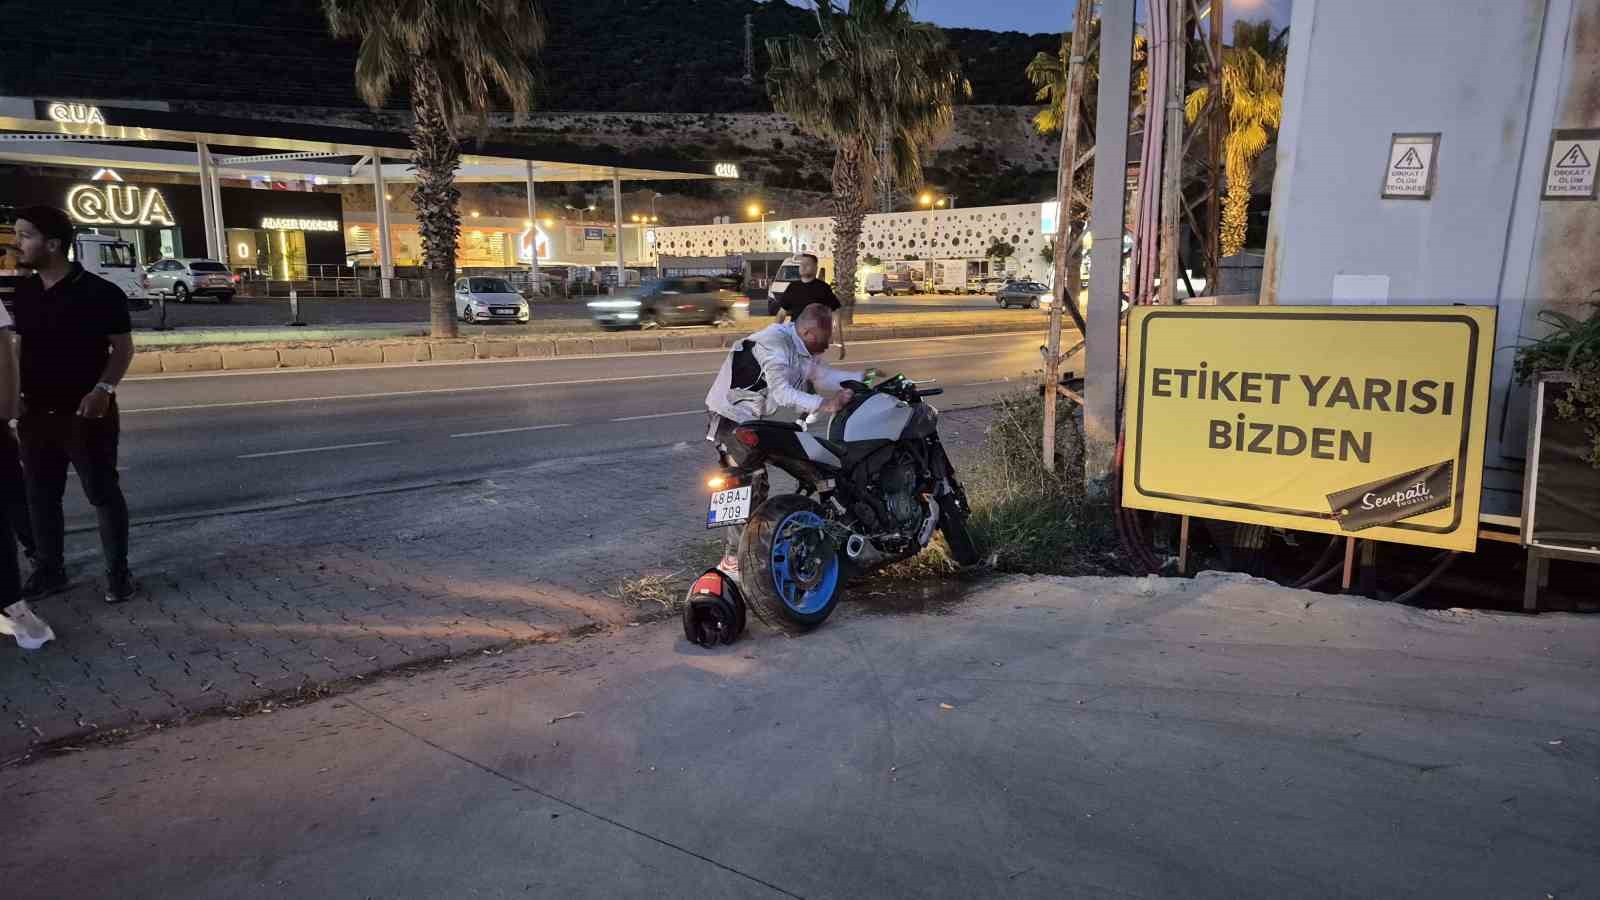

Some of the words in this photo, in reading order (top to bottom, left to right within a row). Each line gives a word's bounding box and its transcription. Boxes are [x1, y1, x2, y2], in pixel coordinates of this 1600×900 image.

[49, 103, 105, 125] QUA
[1151, 361, 1290, 405] ETİKET
[1299, 374, 1455, 416] YARISI
[1208, 412, 1373, 464] BİZDEN
[1360, 482, 1430, 510] Sempati
[721, 505, 741, 519] 709
